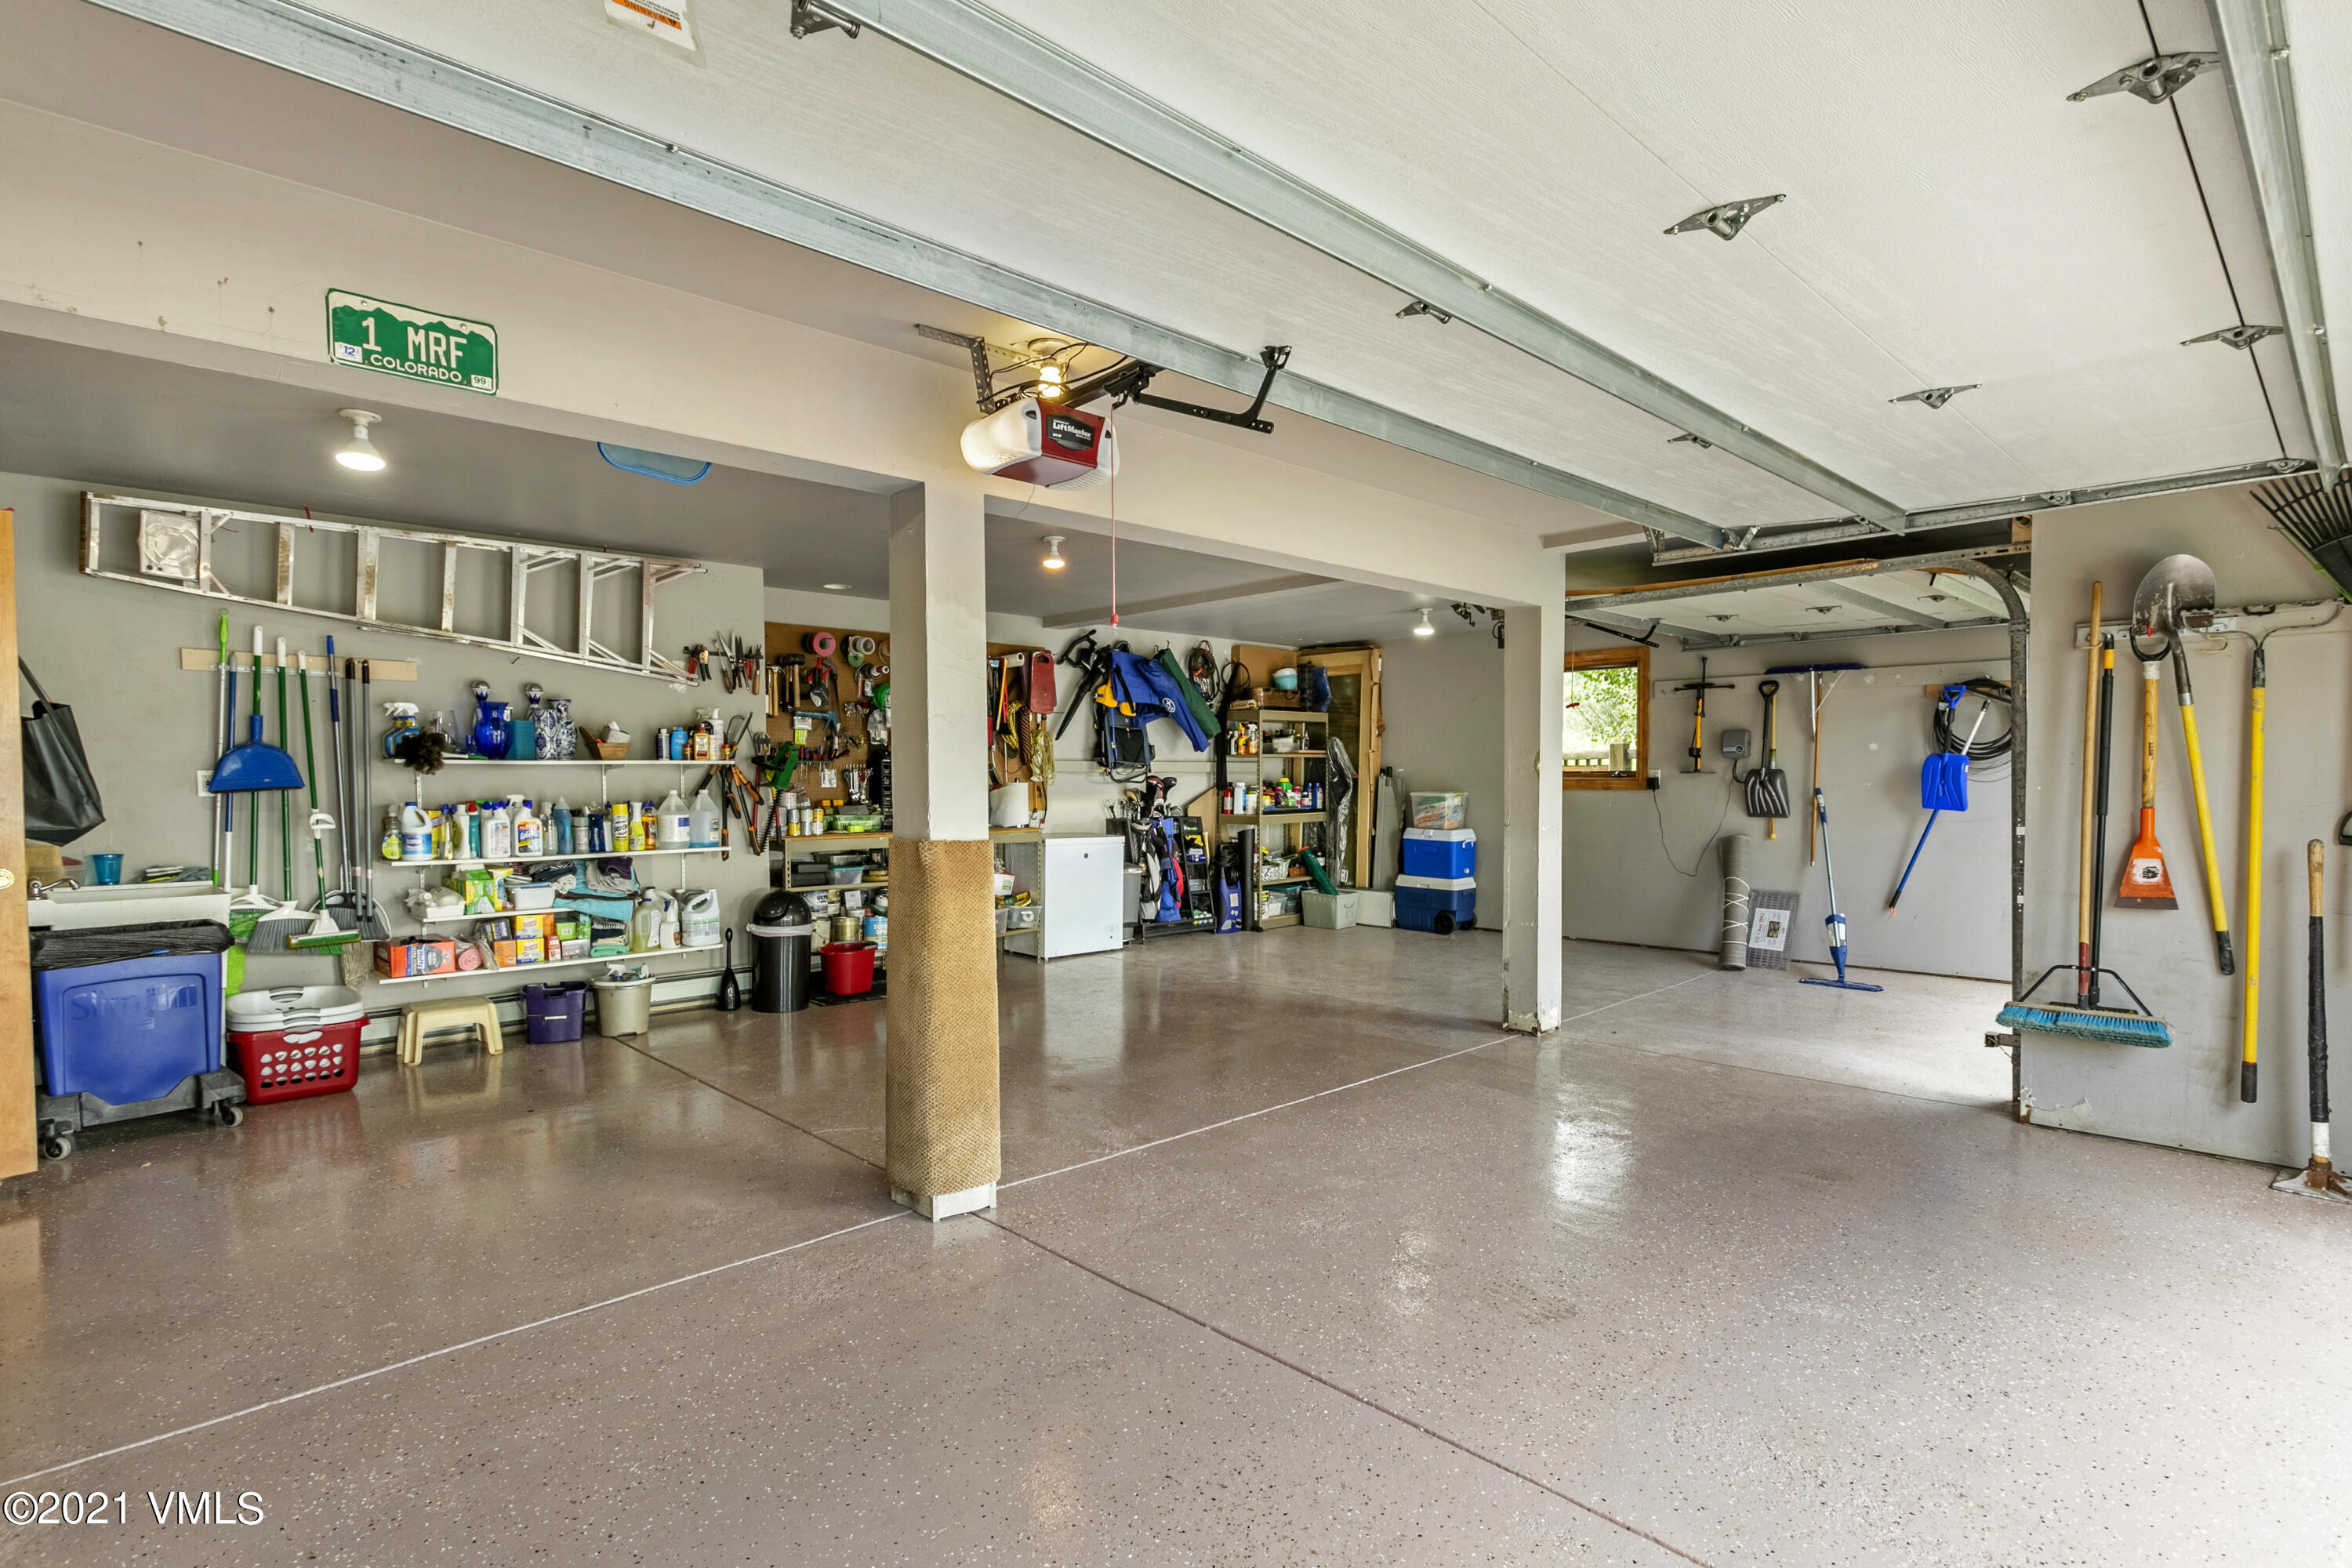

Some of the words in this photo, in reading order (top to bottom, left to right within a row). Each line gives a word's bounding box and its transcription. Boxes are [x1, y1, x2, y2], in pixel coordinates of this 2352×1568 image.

[361, 317, 382, 352] 1
[407, 326, 467, 368] MRF
[343, 345, 355, 357] 12
[370, 354, 463, 383] COLORADO
[474, 376, 487, 386] 99
[1052, 421, 1091, 437] LiftMaster
